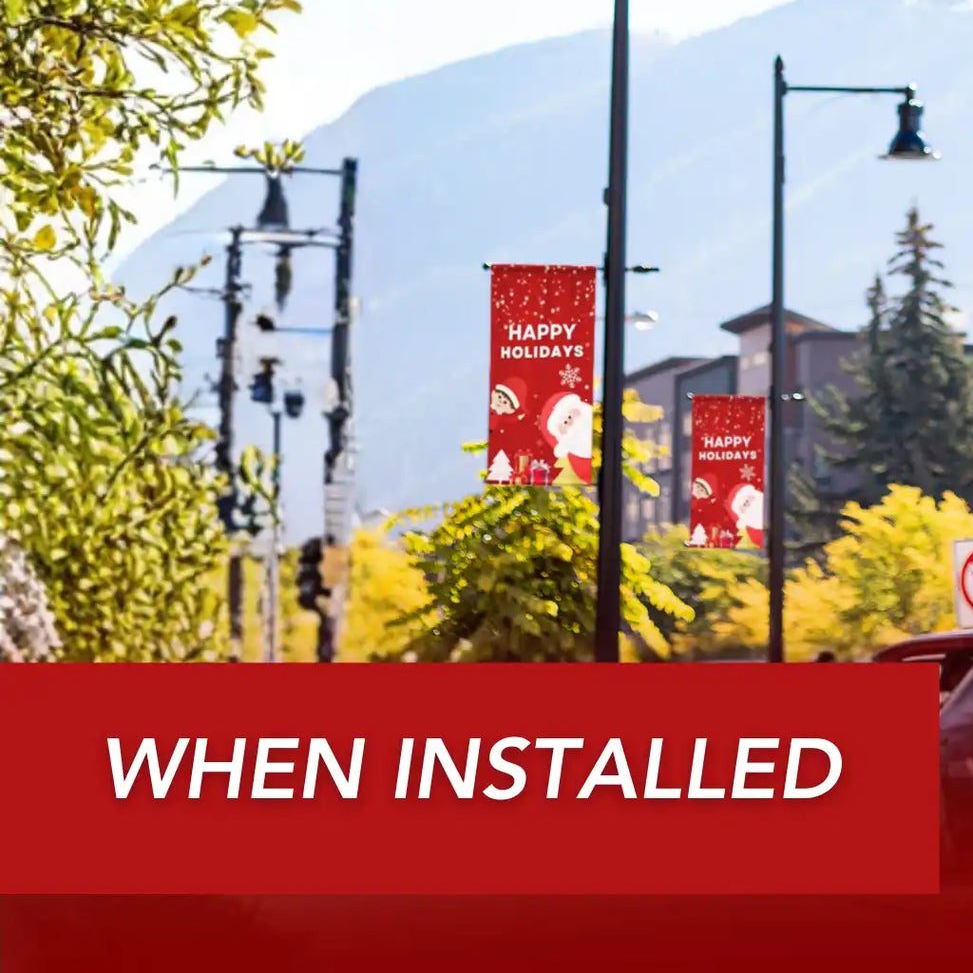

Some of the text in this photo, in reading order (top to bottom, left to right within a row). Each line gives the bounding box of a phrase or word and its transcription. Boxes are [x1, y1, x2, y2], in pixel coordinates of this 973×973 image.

[508, 323, 577, 341] HAPPY
[500, 344, 584, 360] HOLIDAYS
[703, 435, 752, 448] HAPPY
[698, 450, 758, 461] HOLIDAYS
